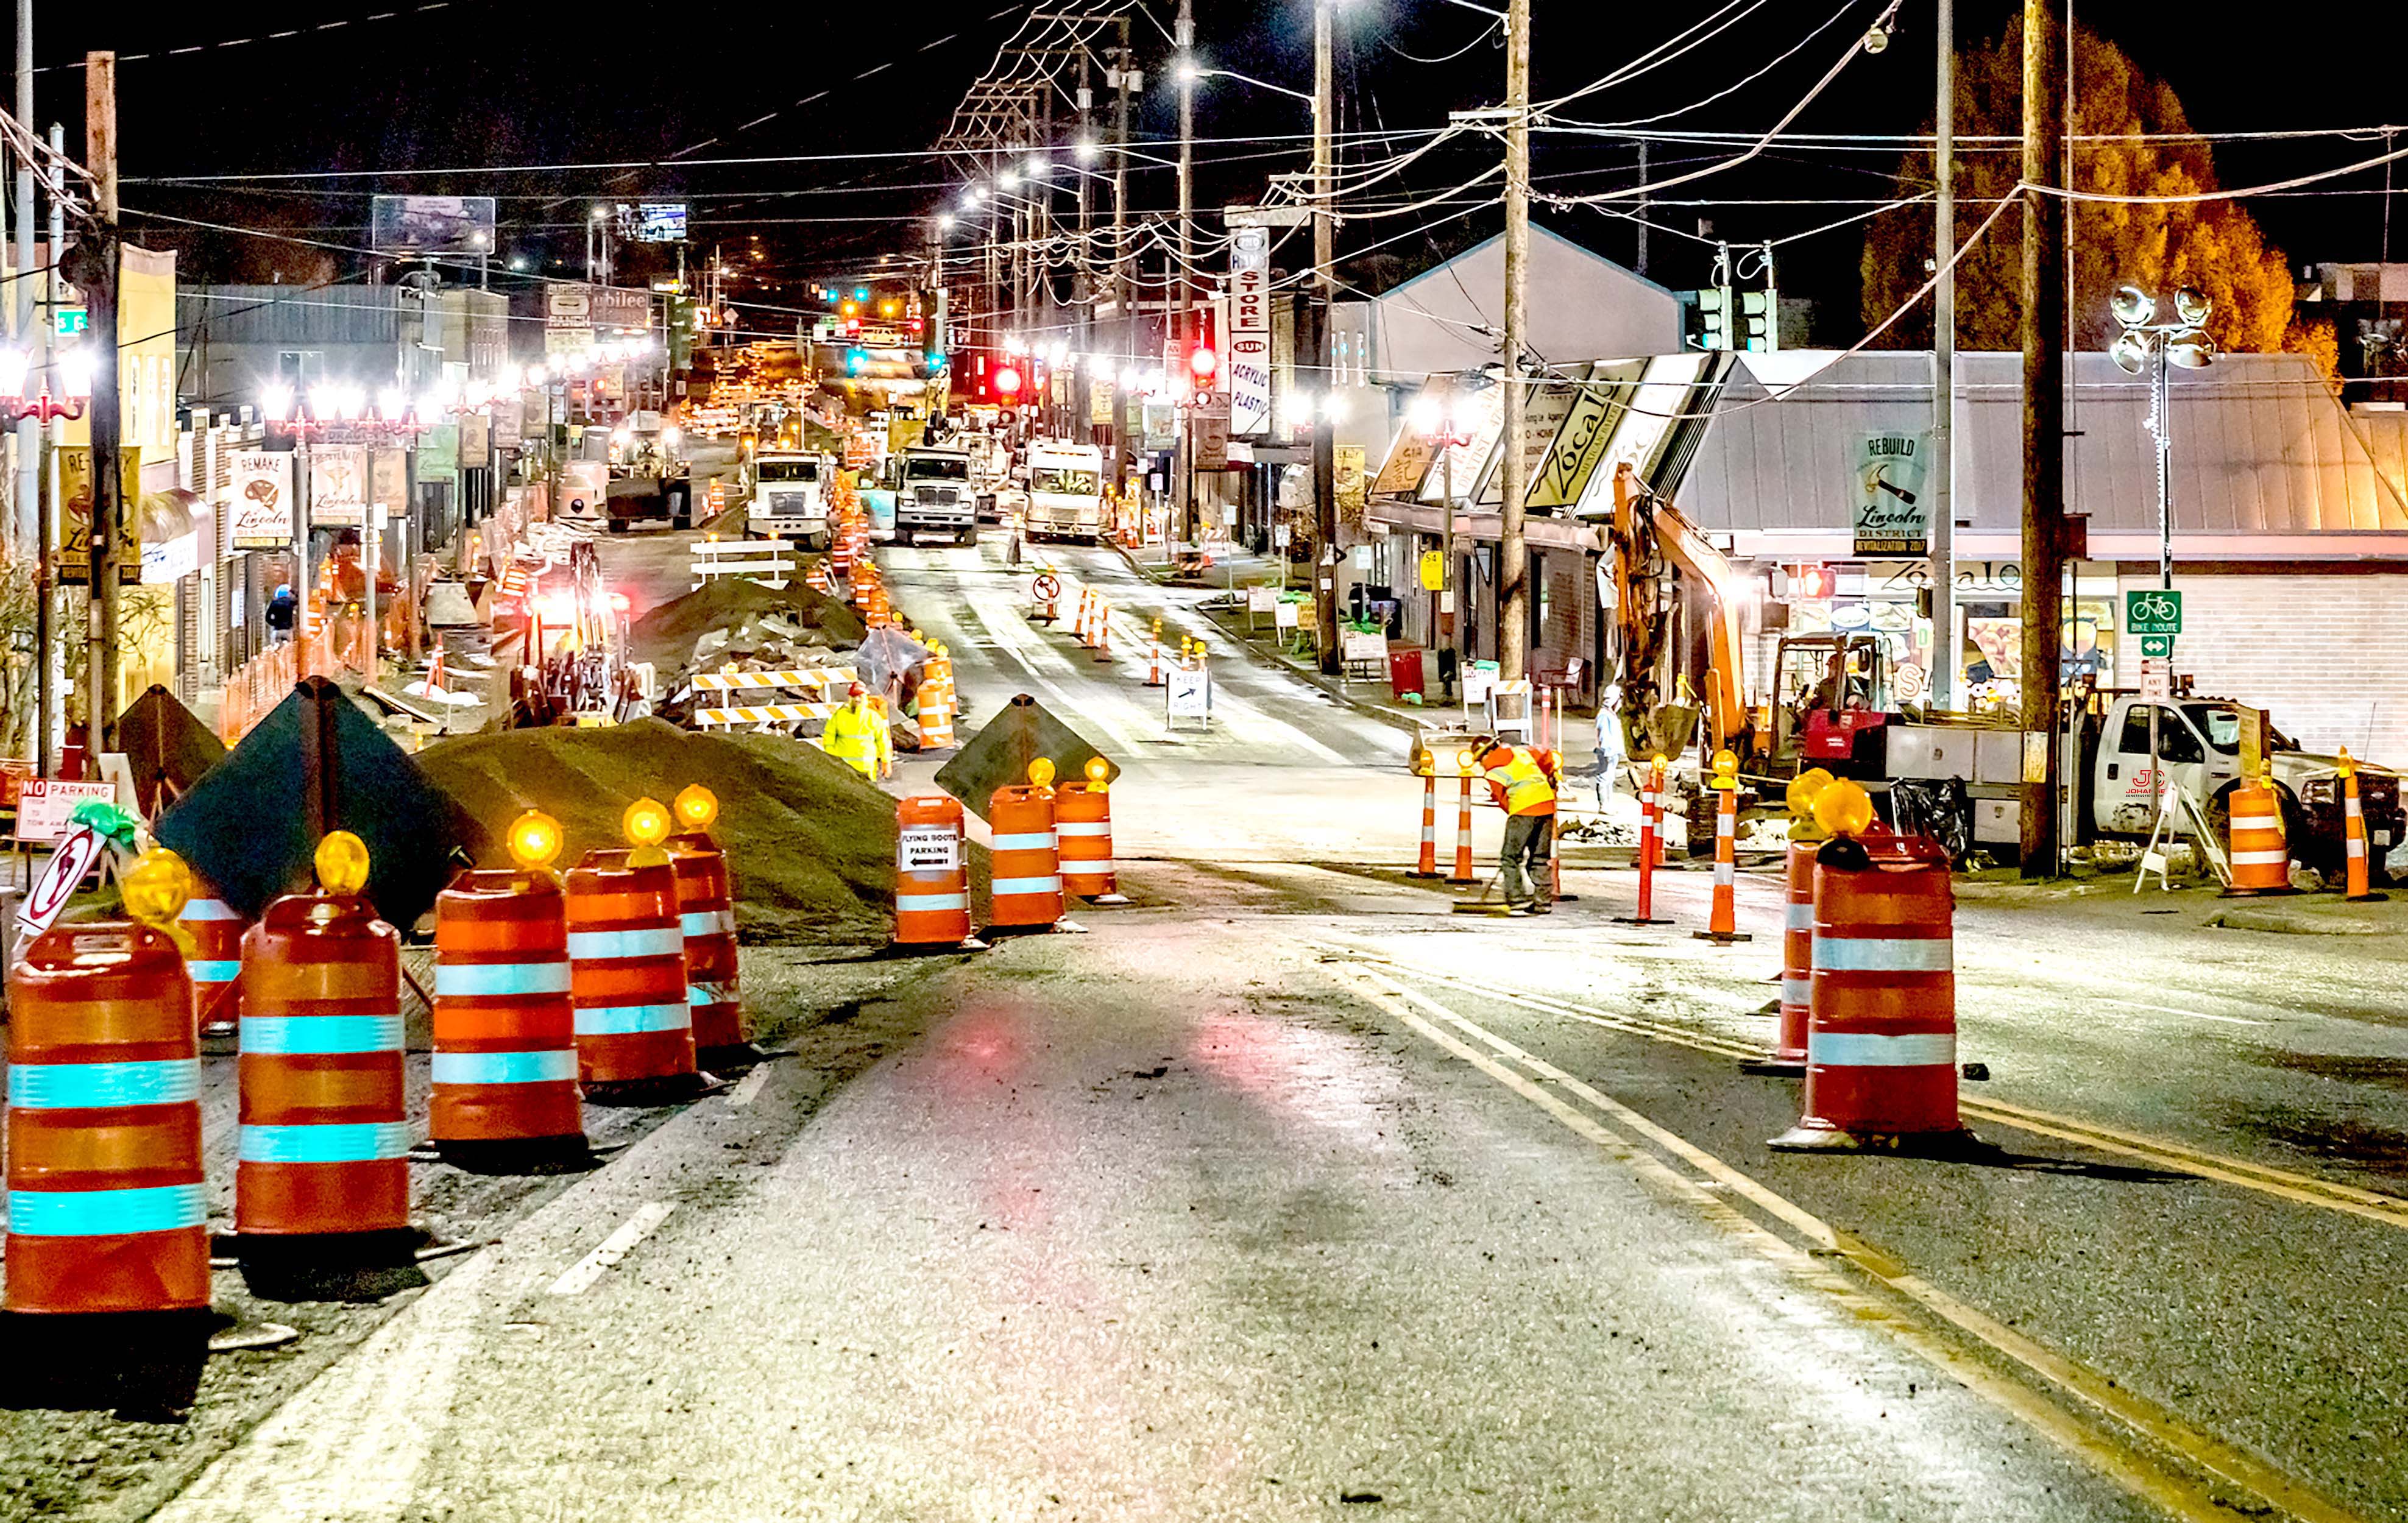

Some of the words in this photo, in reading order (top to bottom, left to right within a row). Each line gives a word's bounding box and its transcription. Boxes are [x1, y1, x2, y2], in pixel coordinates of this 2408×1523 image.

[593, 291, 646, 308] ubilee
[1240, 271, 1260, 327] STORE
[1236, 343, 1264, 352] SUN
[1233, 364, 1268, 387] ACRYLIC
[1233, 391, 1268, 414] PLASTIC
[1868, 437, 1914, 456] REBUILD
[241, 458, 280, 472] REMAKE
[235, 511, 290, 529] Lincoln
[1856, 505, 1926, 529] Lincoln
[1881, 560, 2020, 591] Zóalo
[2131, 623, 2148, 632] BIKE
[2151, 623, 2178, 632] ROUTE
[1177, 676, 1202, 684] KEEP
[2148, 688, 2162, 697] TIME
[23, 780, 46, 795] NO
[51, 785, 109, 798] PARKING
